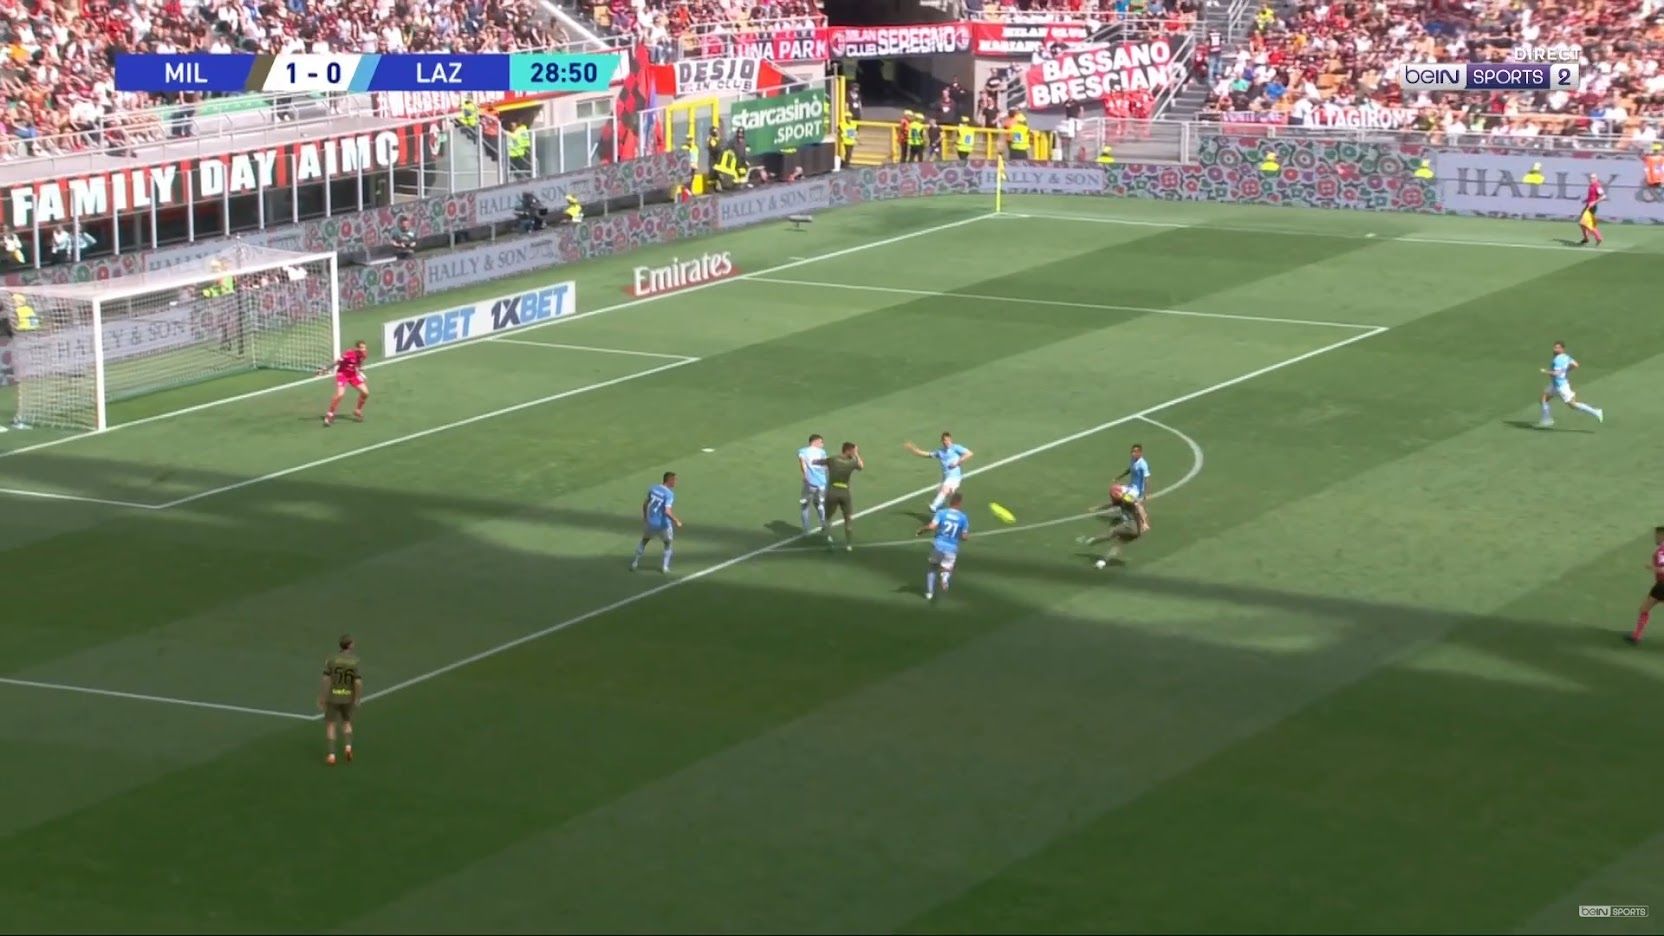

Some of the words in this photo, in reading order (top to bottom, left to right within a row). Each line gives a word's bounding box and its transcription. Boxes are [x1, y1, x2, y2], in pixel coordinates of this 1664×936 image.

[779, 38, 828, 60] PARK
[846, 43, 877, 57] CLUB
[878, 26, 956, 56] SEREGNO
[679, 59, 755, 84] DESIO
[1041, 41, 1171, 83] BASSANO
[716, 78, 753, 93] CLUB
[732, 93, 823, 131] starcasinò
[11, 165, 177, 228] FAMILY
[200, 149, 278, 197] DAY
[986, 170, 1043, 184] HLLY
[1065, 173, 1101, 186] SON
[722, 197, 766, 220] HALLY
[781, 190, 807, 208] SON
[428, 256, 480, 283] HALLY
[483, 253, 494, 271] &
[498, 246, 528, 269] SON
[633, 251, 733, 297] Emirates
[393, 306, 476, 353] 1XBET
[490, 284, 568, 331] 1XBET
[942, 519, 959, 538] 21
